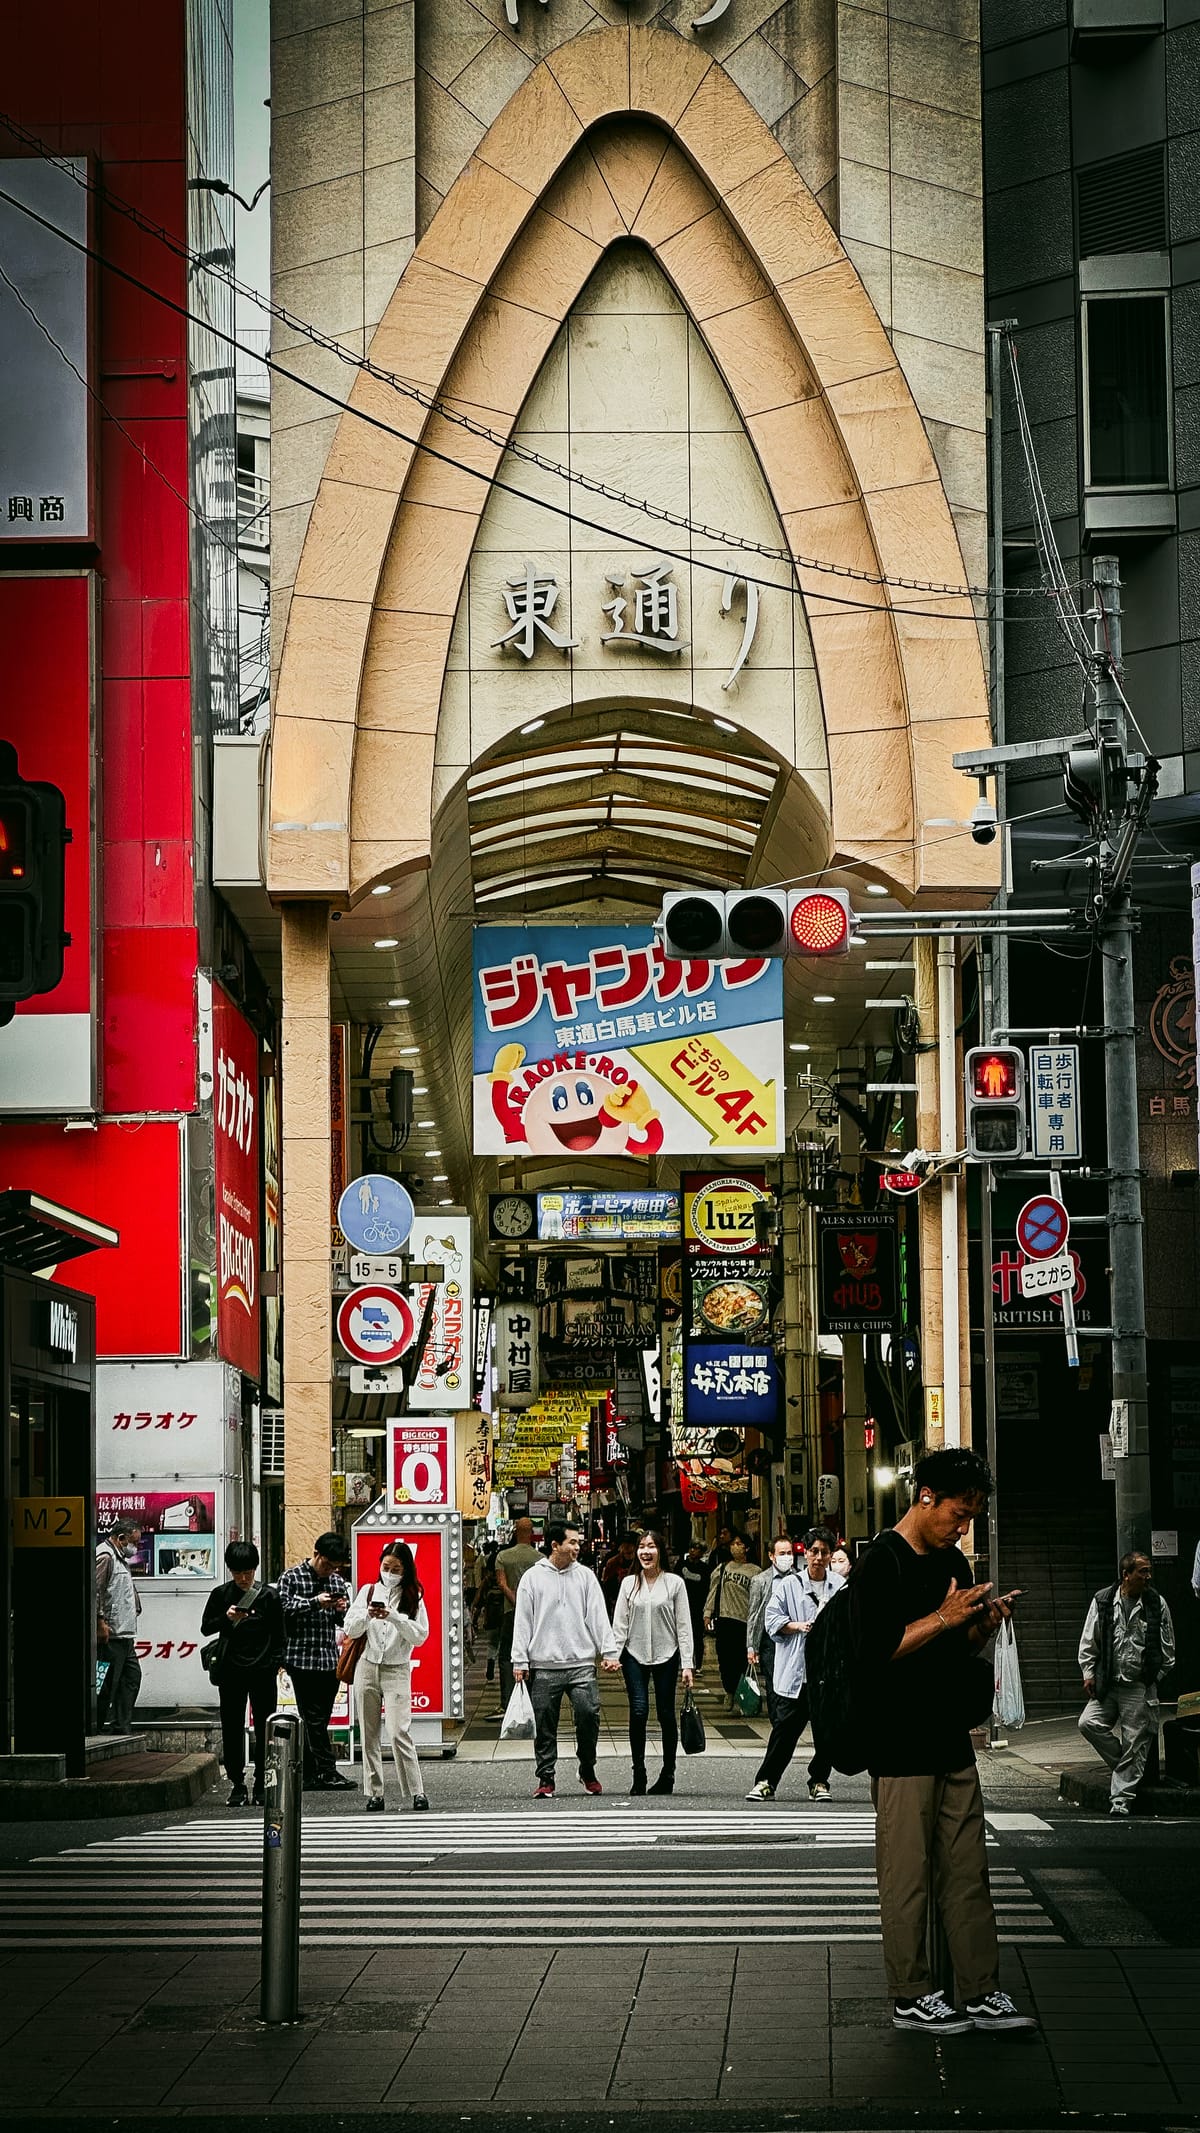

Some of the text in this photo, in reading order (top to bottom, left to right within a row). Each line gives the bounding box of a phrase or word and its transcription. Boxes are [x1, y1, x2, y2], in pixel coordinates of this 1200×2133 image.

[1, 496, 64, 521] 興商
[490, 561, 758, 690] 東通り
[555, 1002, 717, 1048] 東通白馬車ビル店
[689, 1039, 730, 1081] こちらの
[1037, 1054, 1054, 1109] 自転車
[1056, 1054, 1072, 1109] 歩行者
[218, 1048, 253, 1156] カラオケ
[1149, 1096, 1191, 1116] 白馬
[1048, 1114, 1065, 1151] 専用
[565, 1199, 665, 1215] ボートピア梅田
[705, 1201, 754, 1229] luz
[821, 1217, 845, 1225] ALES
[856, 1216, 895, 1224] STOUTS
[219, 1212, 254, 1307] BIG ECHO
[689, 1245, 701, 1253] 3F
[991, 1250, 1086, 1306] HB
[1025, 1265, 1072, 1290] ここから
[833, 1282, 882, 1310] HUB
[51, 1301, 77, 1364] Whity
[565, 1323, 653, 1336] CHRISTMAS
[829, 1322, 851, 1330] FISH
[863, 1321, 893, 1329] CHIPS
[508, 1313, 533, 1394] 中村屋
[112, 1412, 198, 1431] カラオケ
[402, 1431, 439, 1440] BIG ECHO
[403, 1444, 439, 1453] 待ち時間
[98, 1497, 146, 1510] 最新機種
[134, 1641, 198, 1659] ラオケ
